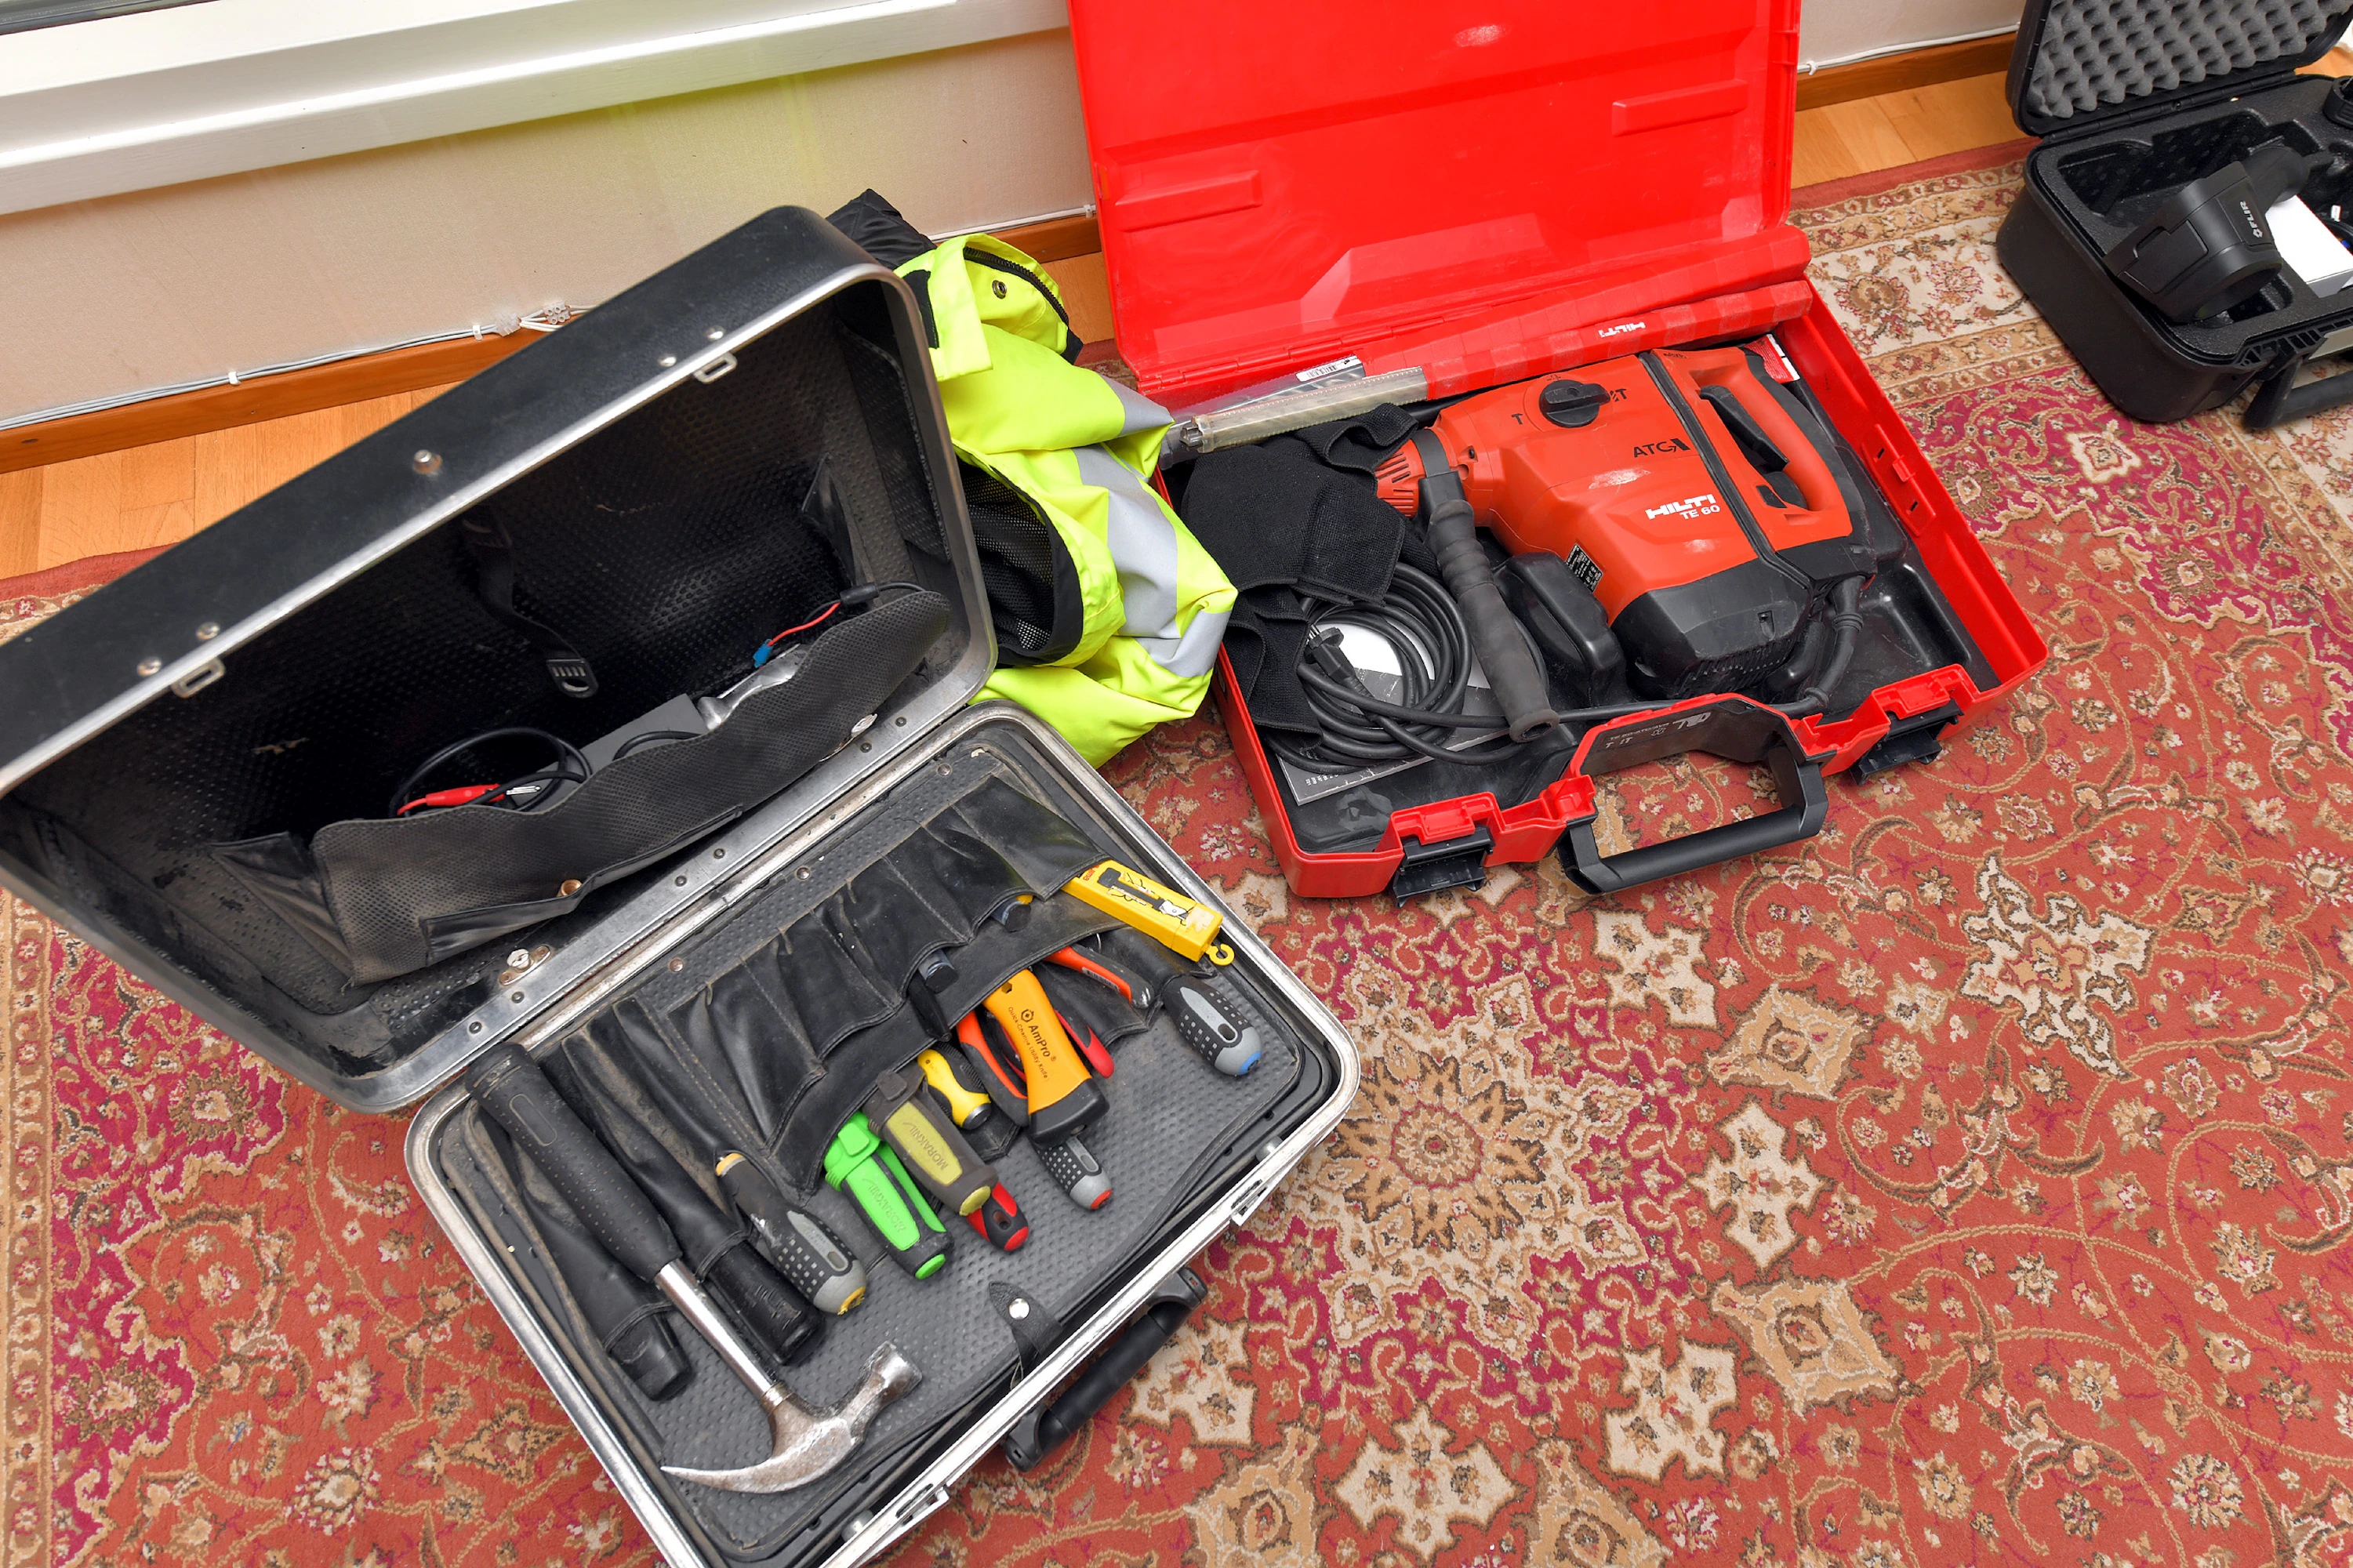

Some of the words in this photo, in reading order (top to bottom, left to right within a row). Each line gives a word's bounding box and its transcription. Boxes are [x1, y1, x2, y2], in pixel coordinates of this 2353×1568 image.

[2240, 201, 2258, 228] FLIR
[1598, 321, 1646, 338] HILTI
[1633, 441, 1673, 458] ATC
[1645, 494, 1716, 520] HILTI
[1679, 509, 1699, 519] TE
[1701, 505, 1720, 514] 60
[1028, 1025, 1051, 1058] AmPro
